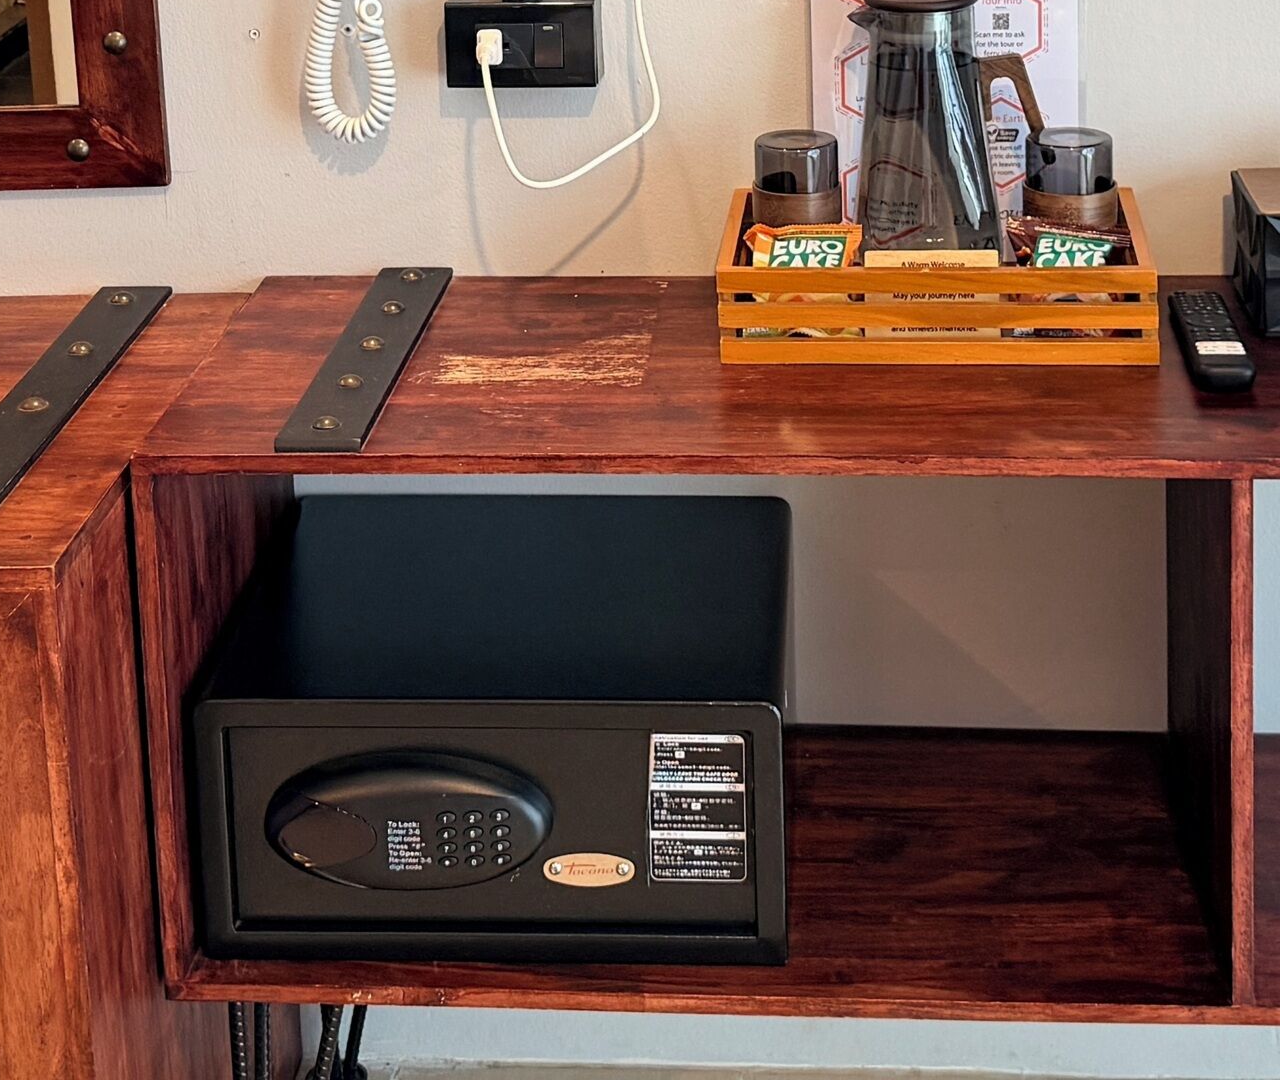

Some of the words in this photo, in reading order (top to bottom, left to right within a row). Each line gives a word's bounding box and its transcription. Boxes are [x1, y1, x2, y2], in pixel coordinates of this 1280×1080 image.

[1003, 114, 1024, 123] Eart
[773, 238, 844, 256] EURO
[770, 253, 840, 268] CAKE
[1035, 251, 1106, 268] CAKE
[892, 293, 908, 301] May
[910, 293, 927, 301] your
[927, 293, 956, 301] journey
[443, 816, 447, 824] 1
[469, 815, 475, 823] 2
[496, 813, 502, 821] 3
[443, 831, 449, 839] 4
